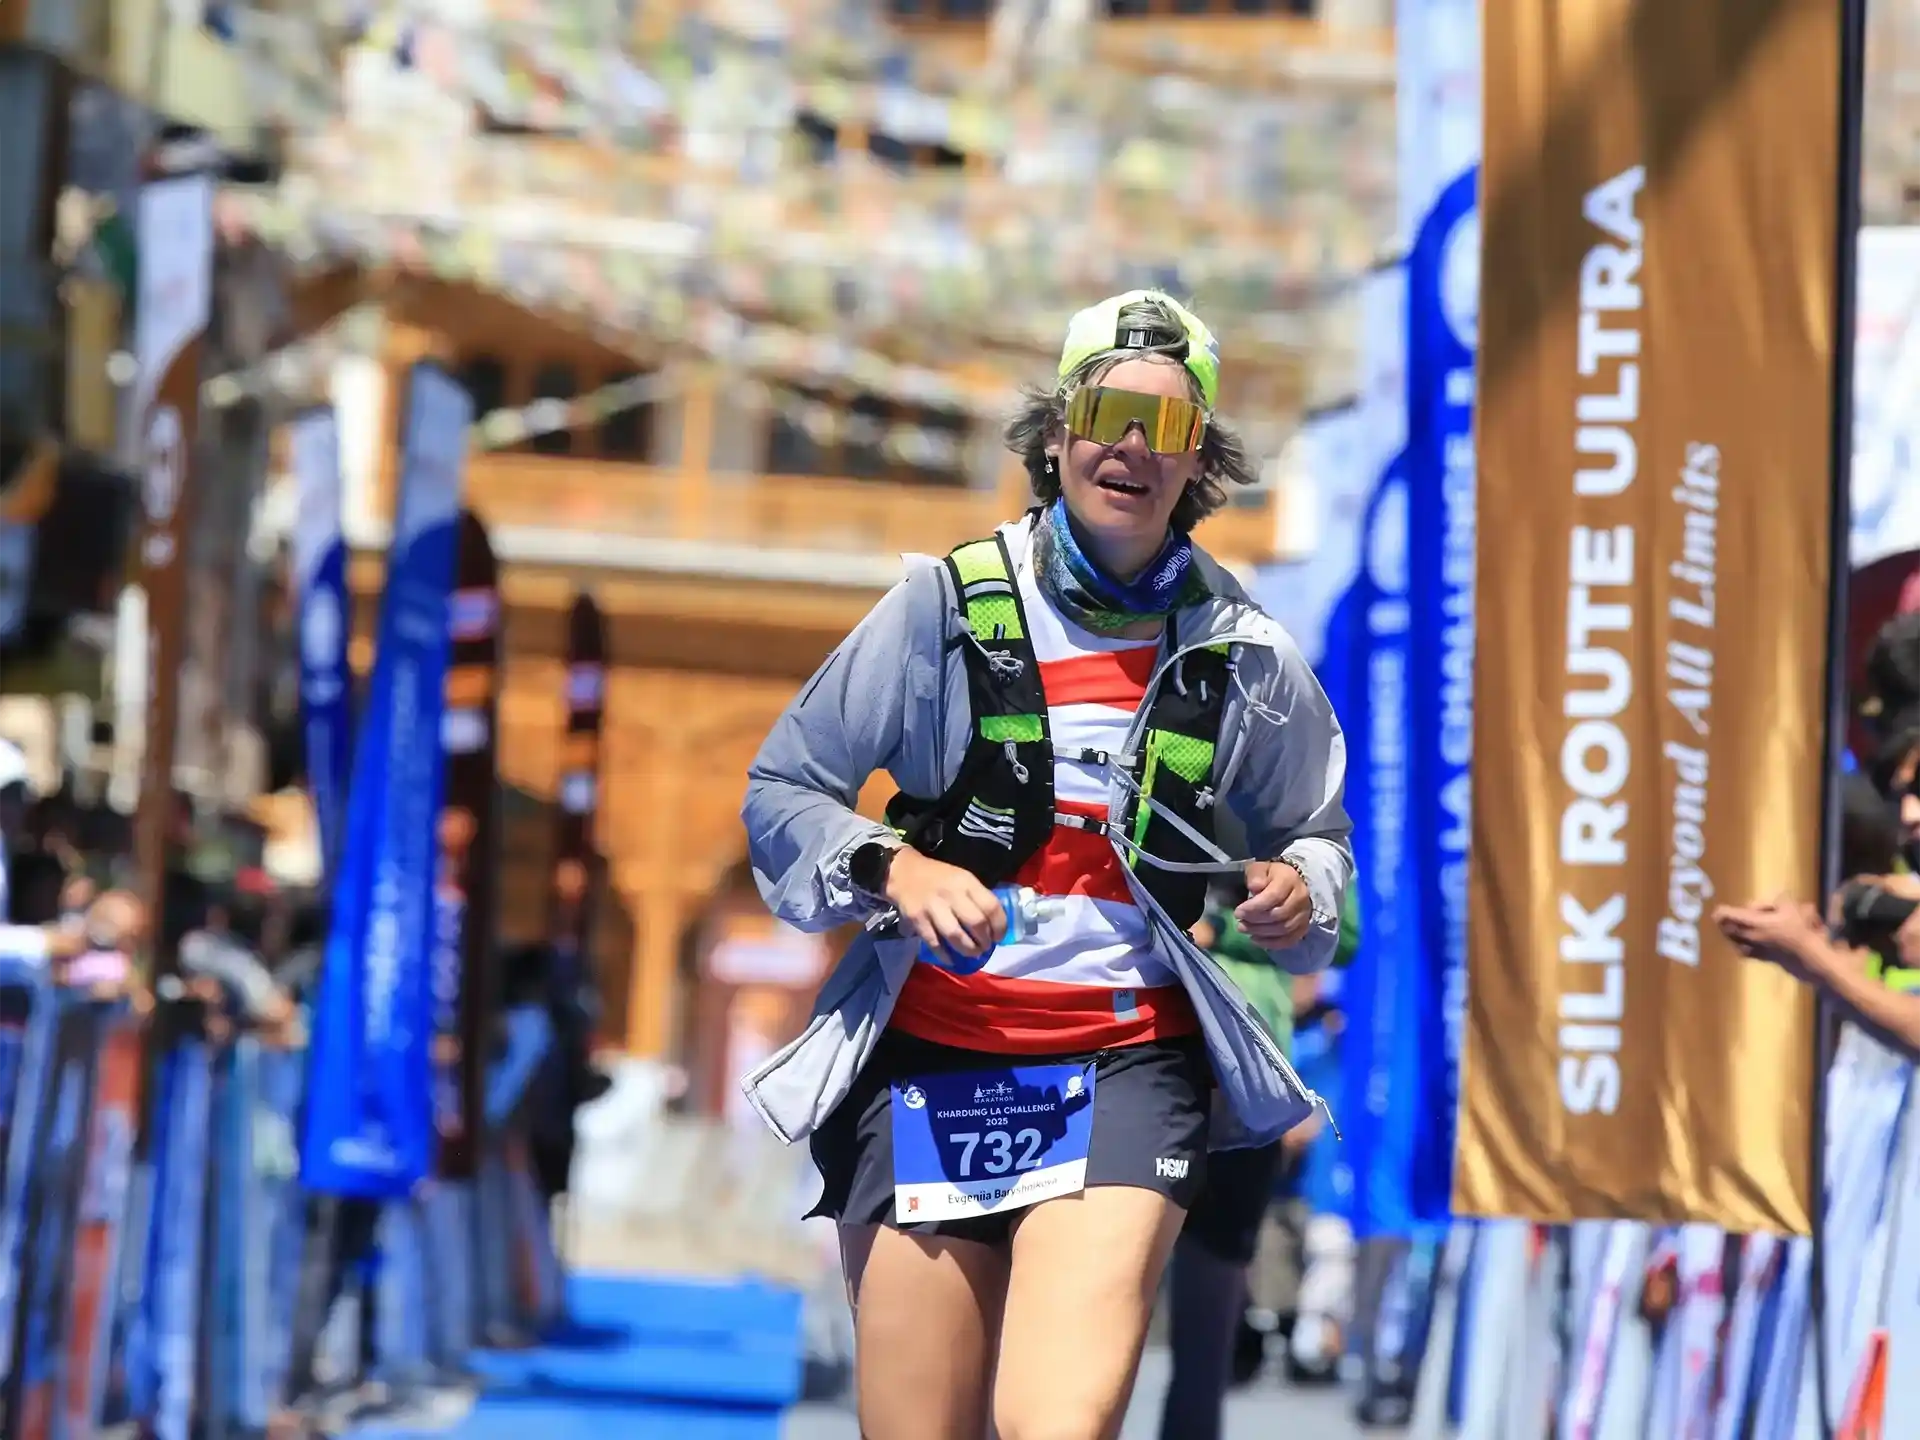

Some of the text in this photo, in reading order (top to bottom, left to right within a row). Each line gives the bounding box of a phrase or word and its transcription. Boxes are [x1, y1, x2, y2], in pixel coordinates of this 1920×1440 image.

[1557, 164, 1646, 1115] SILK ROUTE ULTRA
[1656, 440, 1722, 968] Beyond All Limits
[974, 1096, 1014, 1104] MARATHON
[937, 1103, 1056, 1118] KHARDUNG LA CHALLENGE
[985, 1117, 1008, 1126] 2025
[949, 1128, 1042, 1177] 732
[947, 1190, 992, 1205] Evgeniia
